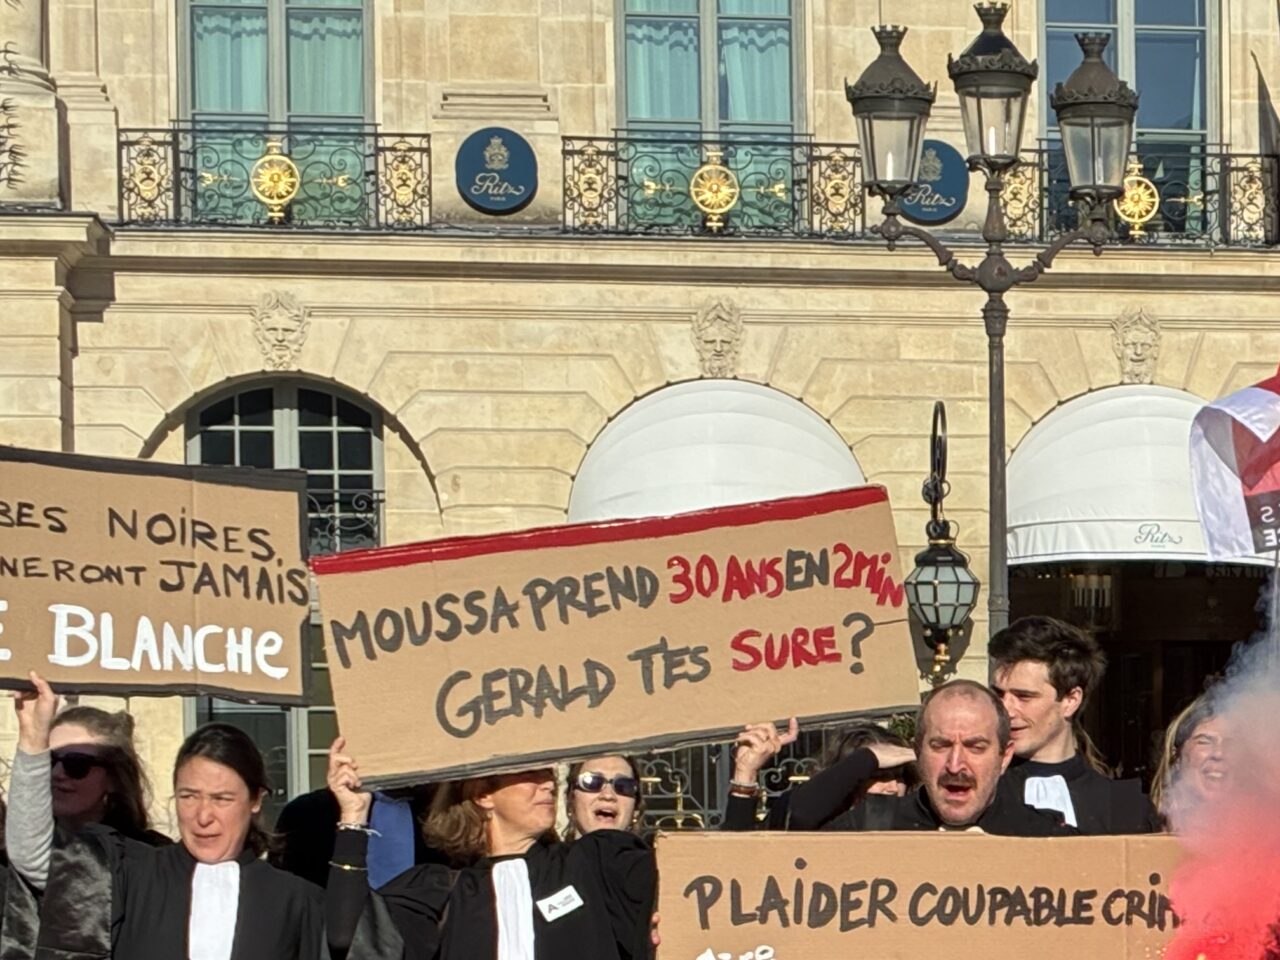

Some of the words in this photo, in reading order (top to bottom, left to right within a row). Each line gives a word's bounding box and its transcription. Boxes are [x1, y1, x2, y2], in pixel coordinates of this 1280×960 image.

[470, 172, 525, 196] Ritz
[903, 183, 957, 207] Ritz
[1134, 523, 1183, 544] Ritz
[330, 585, 520, 669] MOUSSA
[522, 565, 660, 631] PREND
[436, 658, 616, 739] GERALD
[908, 882, 1098, 927] COUPABLE
